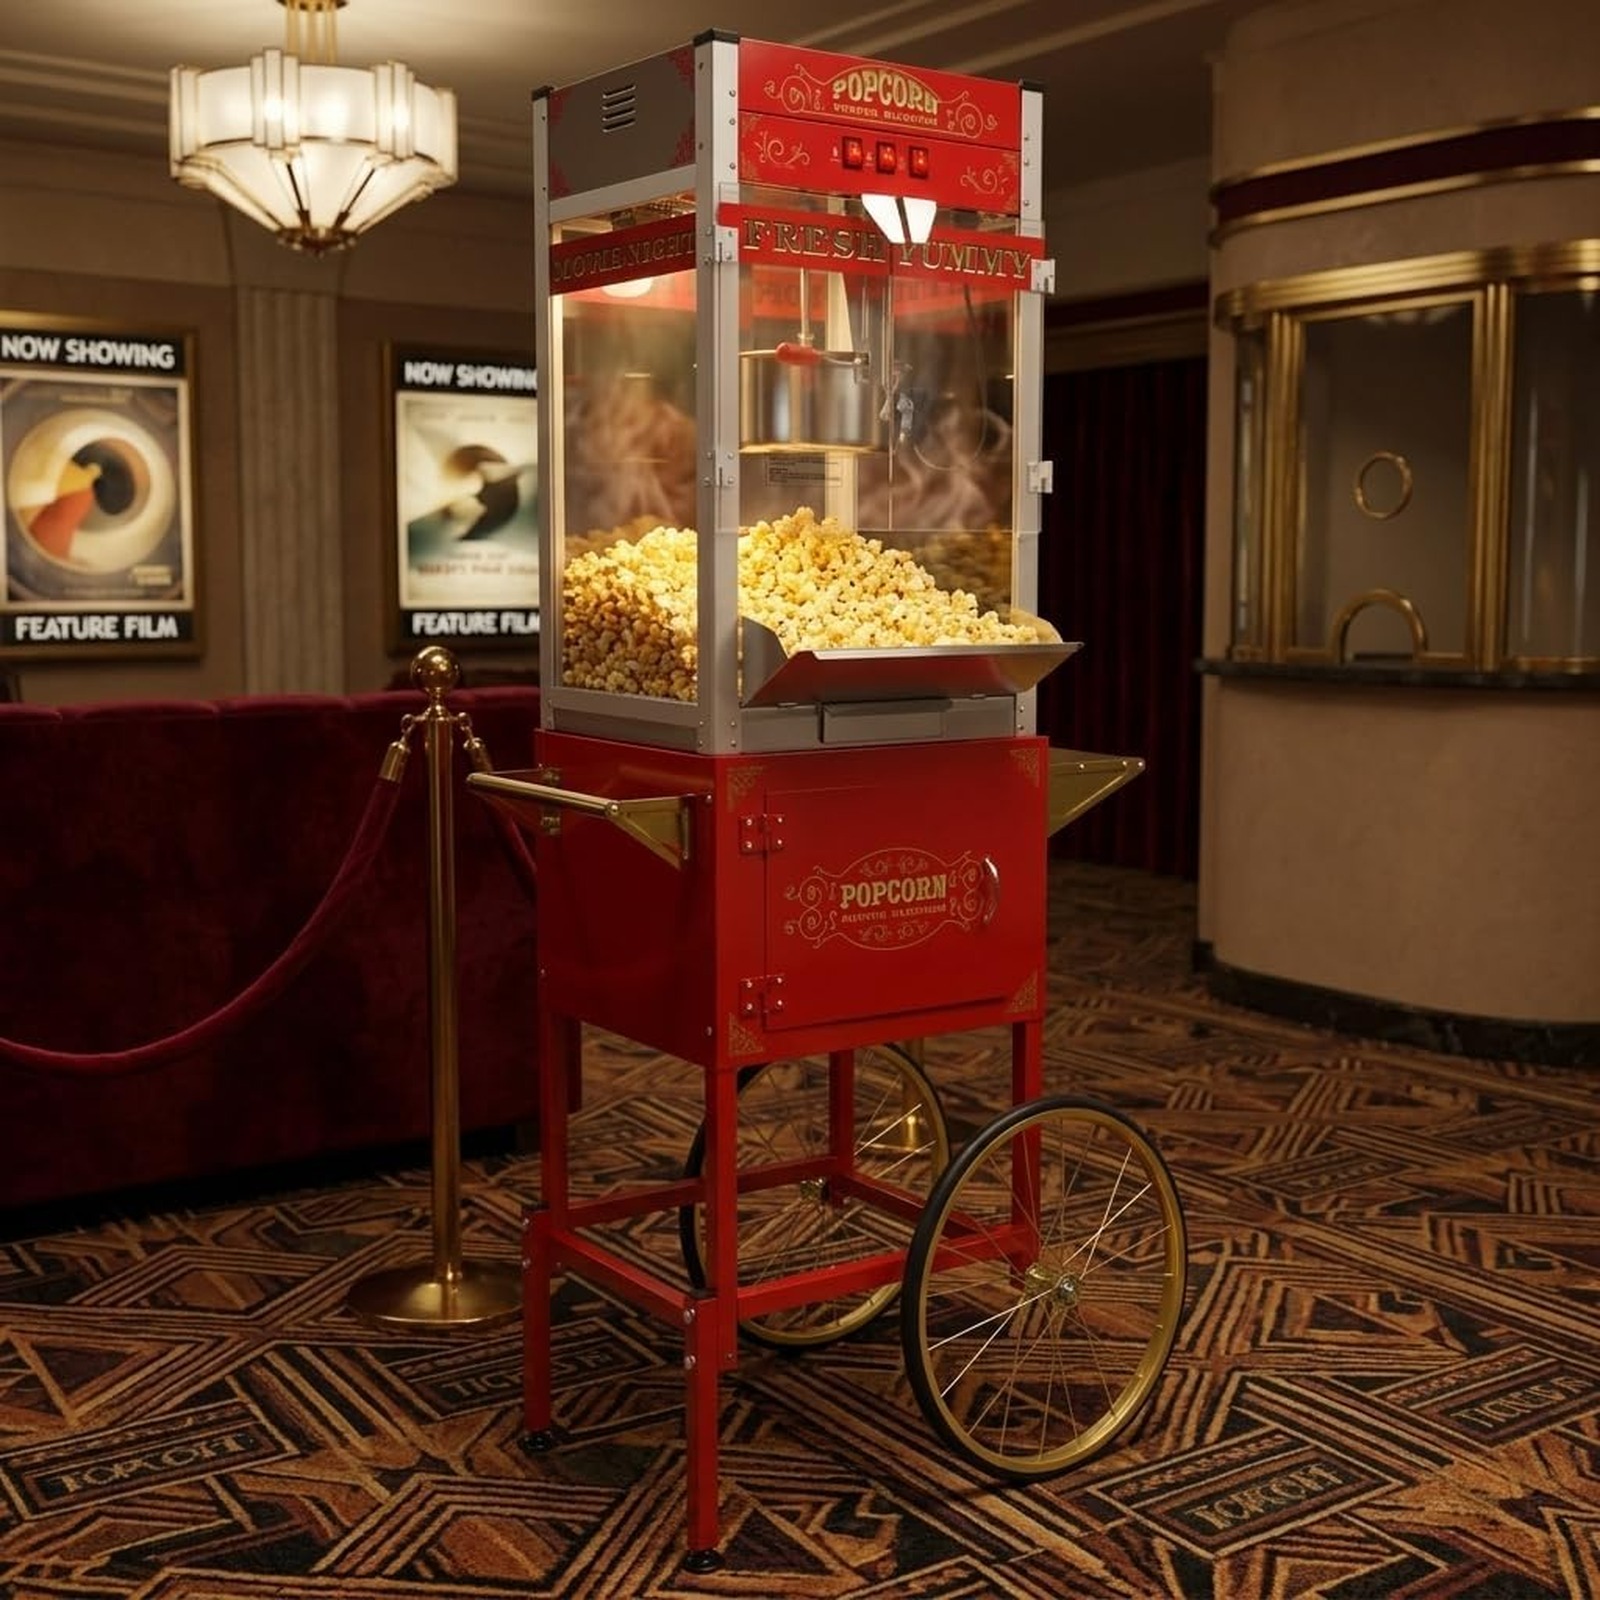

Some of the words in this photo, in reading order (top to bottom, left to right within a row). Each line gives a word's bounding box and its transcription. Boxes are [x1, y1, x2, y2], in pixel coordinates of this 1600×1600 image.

[832, 69, 938, 115] POPCORN
[743, 217, 886, 263] FRESH
[899, 240, 1031, 279] YUMMY
[1, 335, 60, 361] NOW
[65, 339, 175, 369] SHOWING
[404, 361, 454, 385] NOW
[15, 615, 119, 640] FEATURE
[124, 615, 178, 639] FILM
[412, 611, 498, 635] FEATURE
[840, 874, 946, 909] POPCORN
